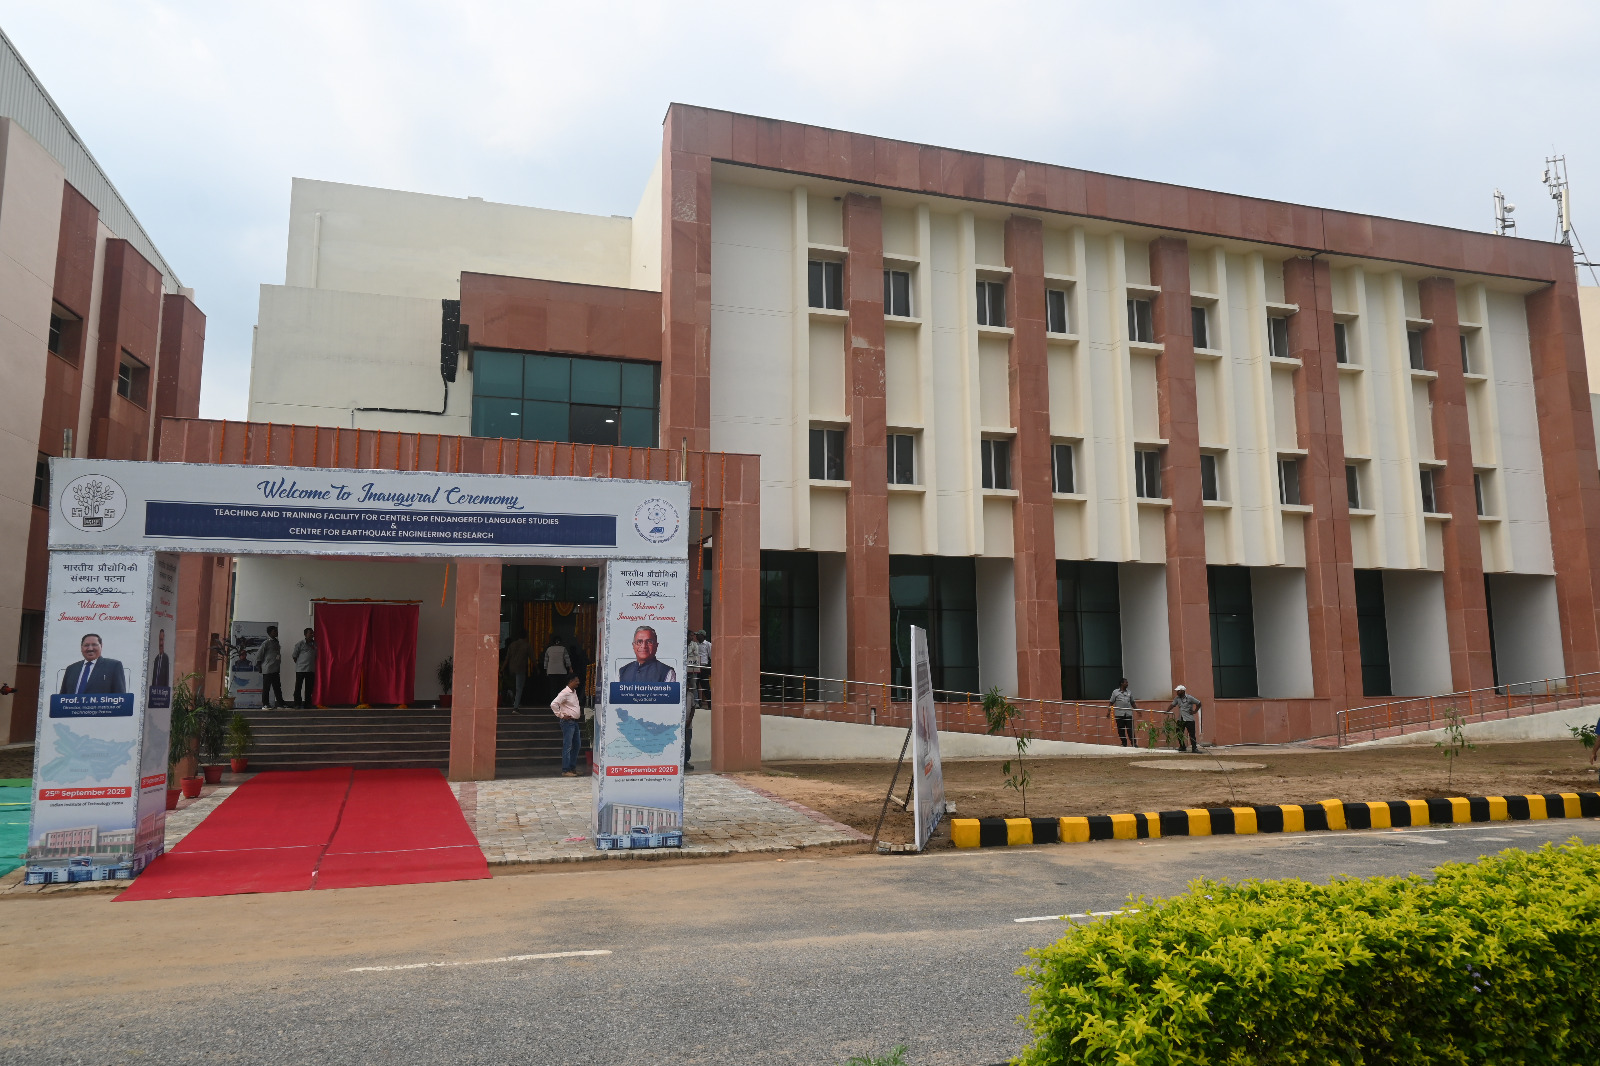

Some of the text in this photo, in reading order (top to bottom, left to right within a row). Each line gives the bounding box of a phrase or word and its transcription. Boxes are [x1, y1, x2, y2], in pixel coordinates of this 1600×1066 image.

[257, 477, 331, 500] Welcome
[358, 482, 441, 507] Inaugural
[444, 486, 525, 510] Ceremony
[214, 508, 259, 517] TEACHING
[260, 510, 280, 518] AND
[282, 511, 322, 519] TRAINING
[323, 512, 360, 520] FACILITY
[361, 513, 378, 521] FOR
[379, 514, 411, 522] CENTRE
[430, 515, 484, 524] ENDANGERED
[484, 516, 527, 525] LANGUAGE
[528, 517, 559, 525] STUDIES
[288, 527, 494, 539] CENTRE FOR EARTHQUAKE ENGINEERING RESEARCH
[63, 562, 138, 572] भारतीय प्रौद्योगिकी
[70, 573, 99, 582] संस्थान
[620, 569, 678, 579] भारतीय प्रौद्योगिकी
[625, 579, 648, 587] संस्थान
[77, 599, 111, 609] Welcome
[631, 602, 657, 610] Welcome
[58, 611, 136, 622] Inaugural Ceremony
[617, 612, 678, 623] Inaugural Ceremony
[60, 696, 79, 704] Prof.
[82, 696, 88, 704] T.
[100, 696, 125, 704] Singh
[623, 767, 658, 775] September
[61, 790, 105, 798] September
